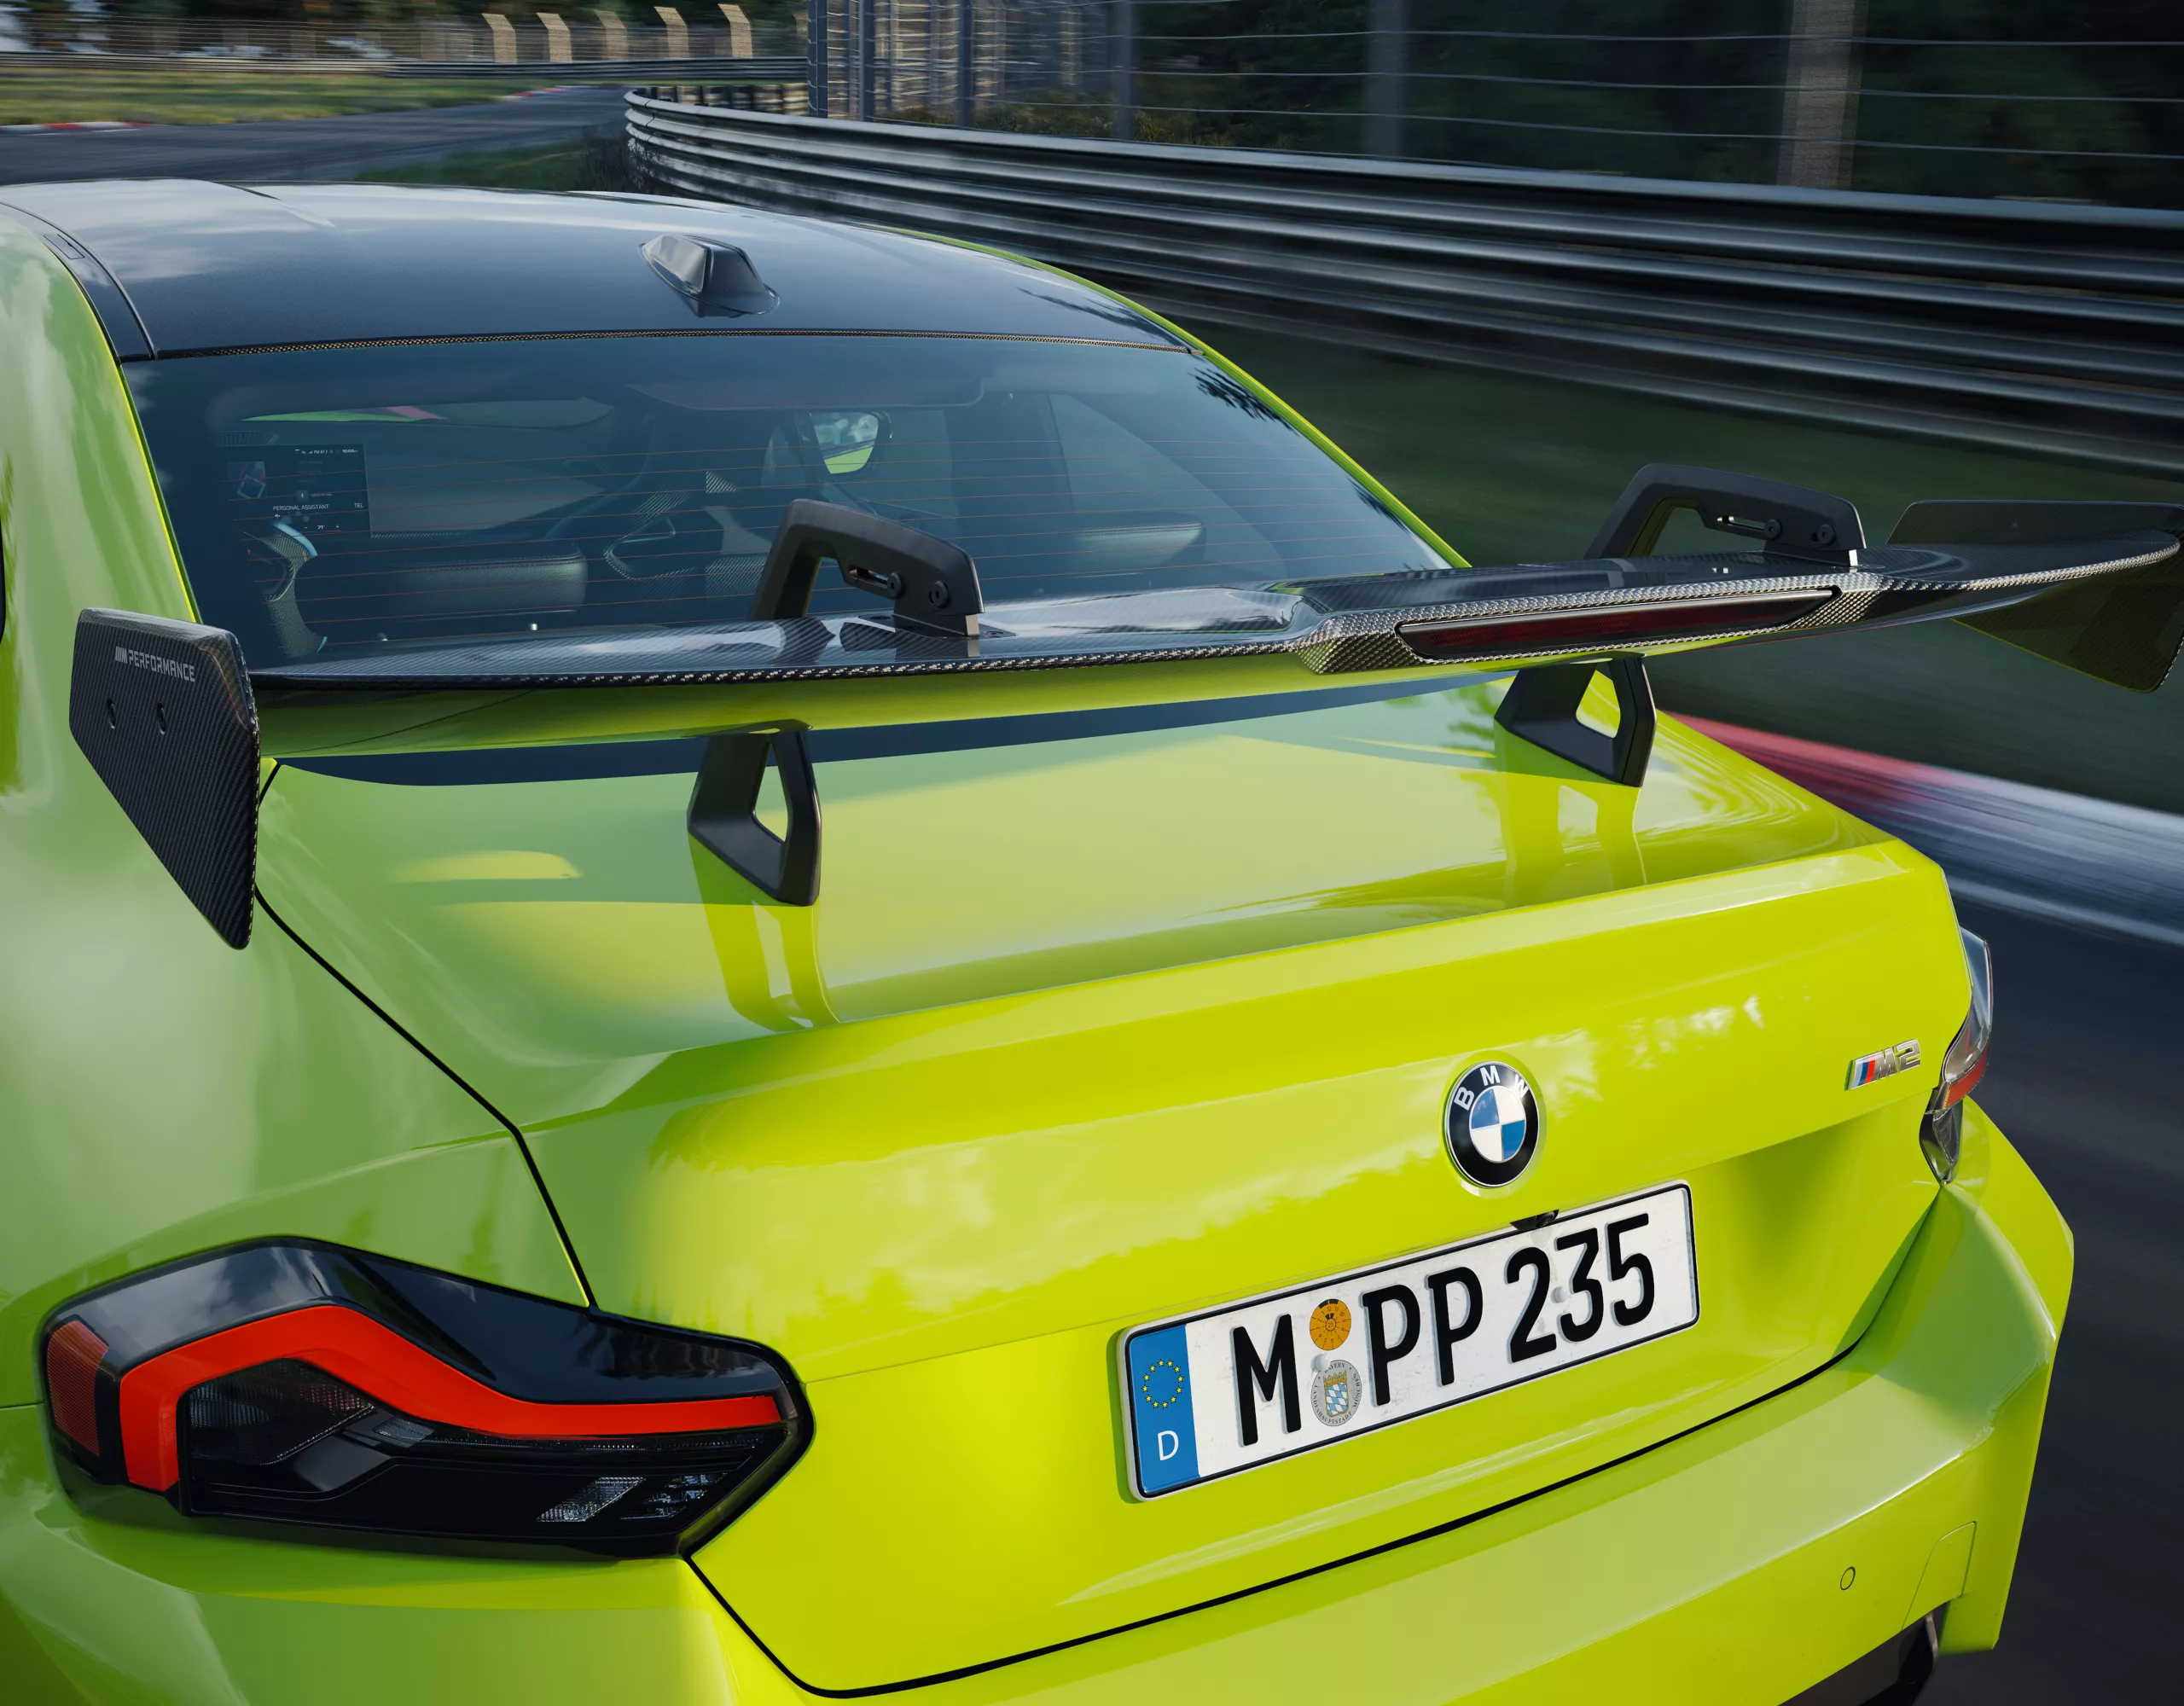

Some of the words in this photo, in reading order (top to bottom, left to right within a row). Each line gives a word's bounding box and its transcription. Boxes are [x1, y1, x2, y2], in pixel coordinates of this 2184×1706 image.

[128, 648, 195, 682] PERFORMANCE
[1850, 1038, 1921, 1090] M2
[1453, 1065, 1531, 1111] BMW
[1230, 1313, 1303, 1448] M
[1362, 1266, 1484, 1407] PP
[1504, 1212, 1656, 1364] 235
[1157, 1430, 1180, 1462] D
